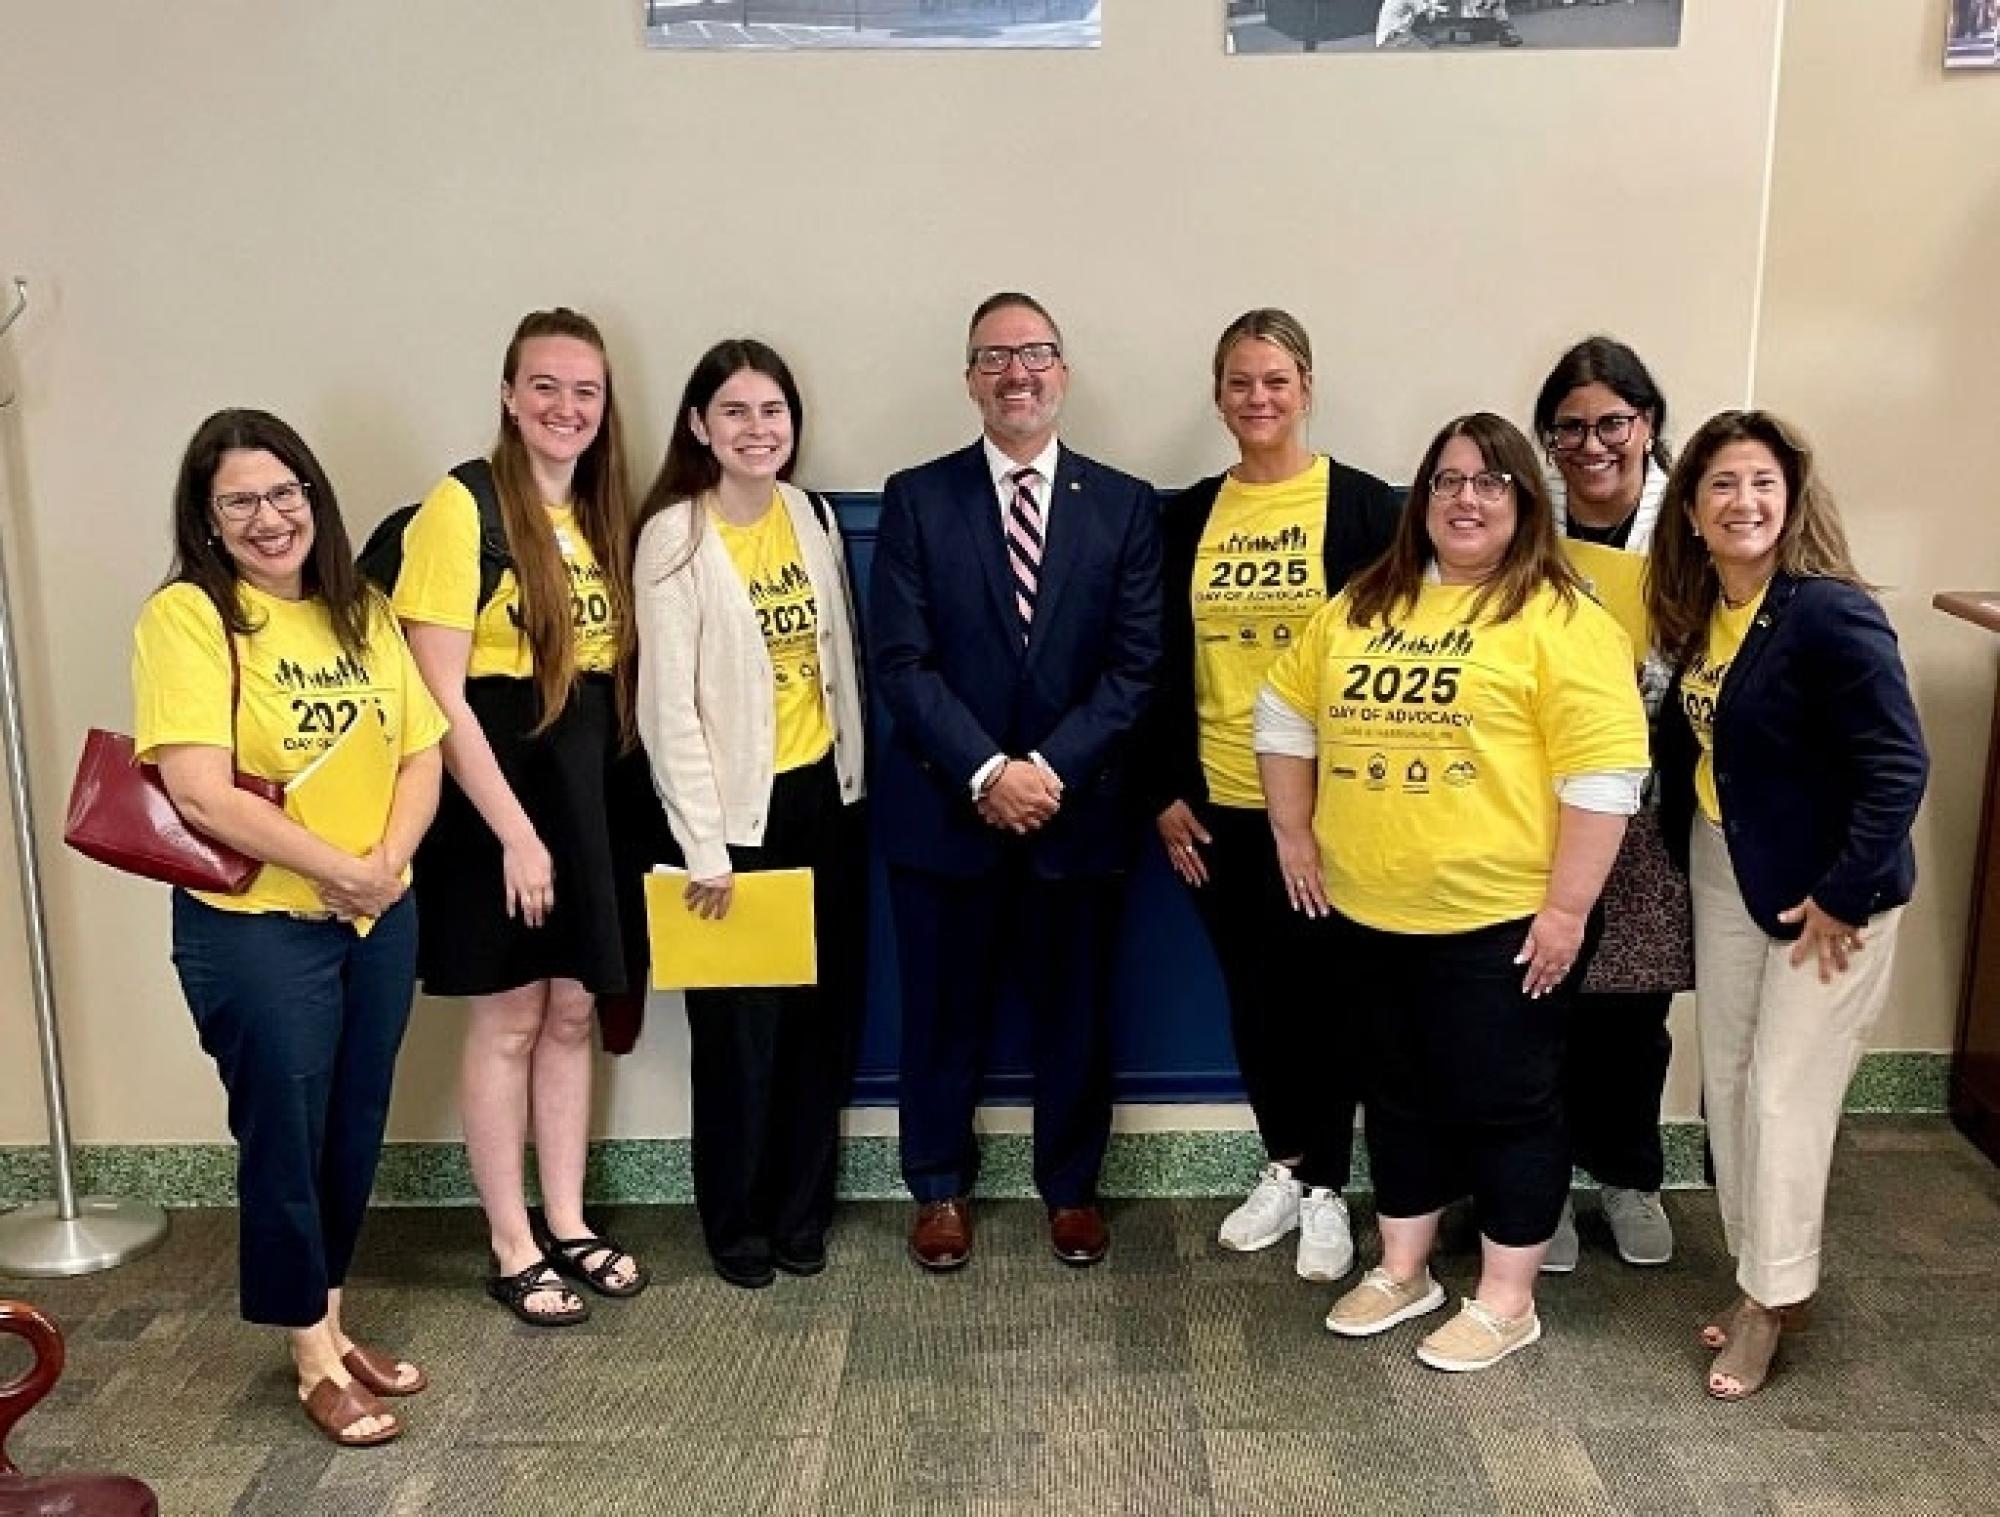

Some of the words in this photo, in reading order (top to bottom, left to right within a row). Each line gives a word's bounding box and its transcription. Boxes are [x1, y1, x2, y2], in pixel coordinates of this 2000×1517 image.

[1209, 560, 1307, 588] 2025
[1343, 664, 1462, 705] 2025
[1329, 705, 1356, 718] DAY
[1361, 708, 1381, 721] OF
[1385, 709, 1473, 727] ADVOCACY
